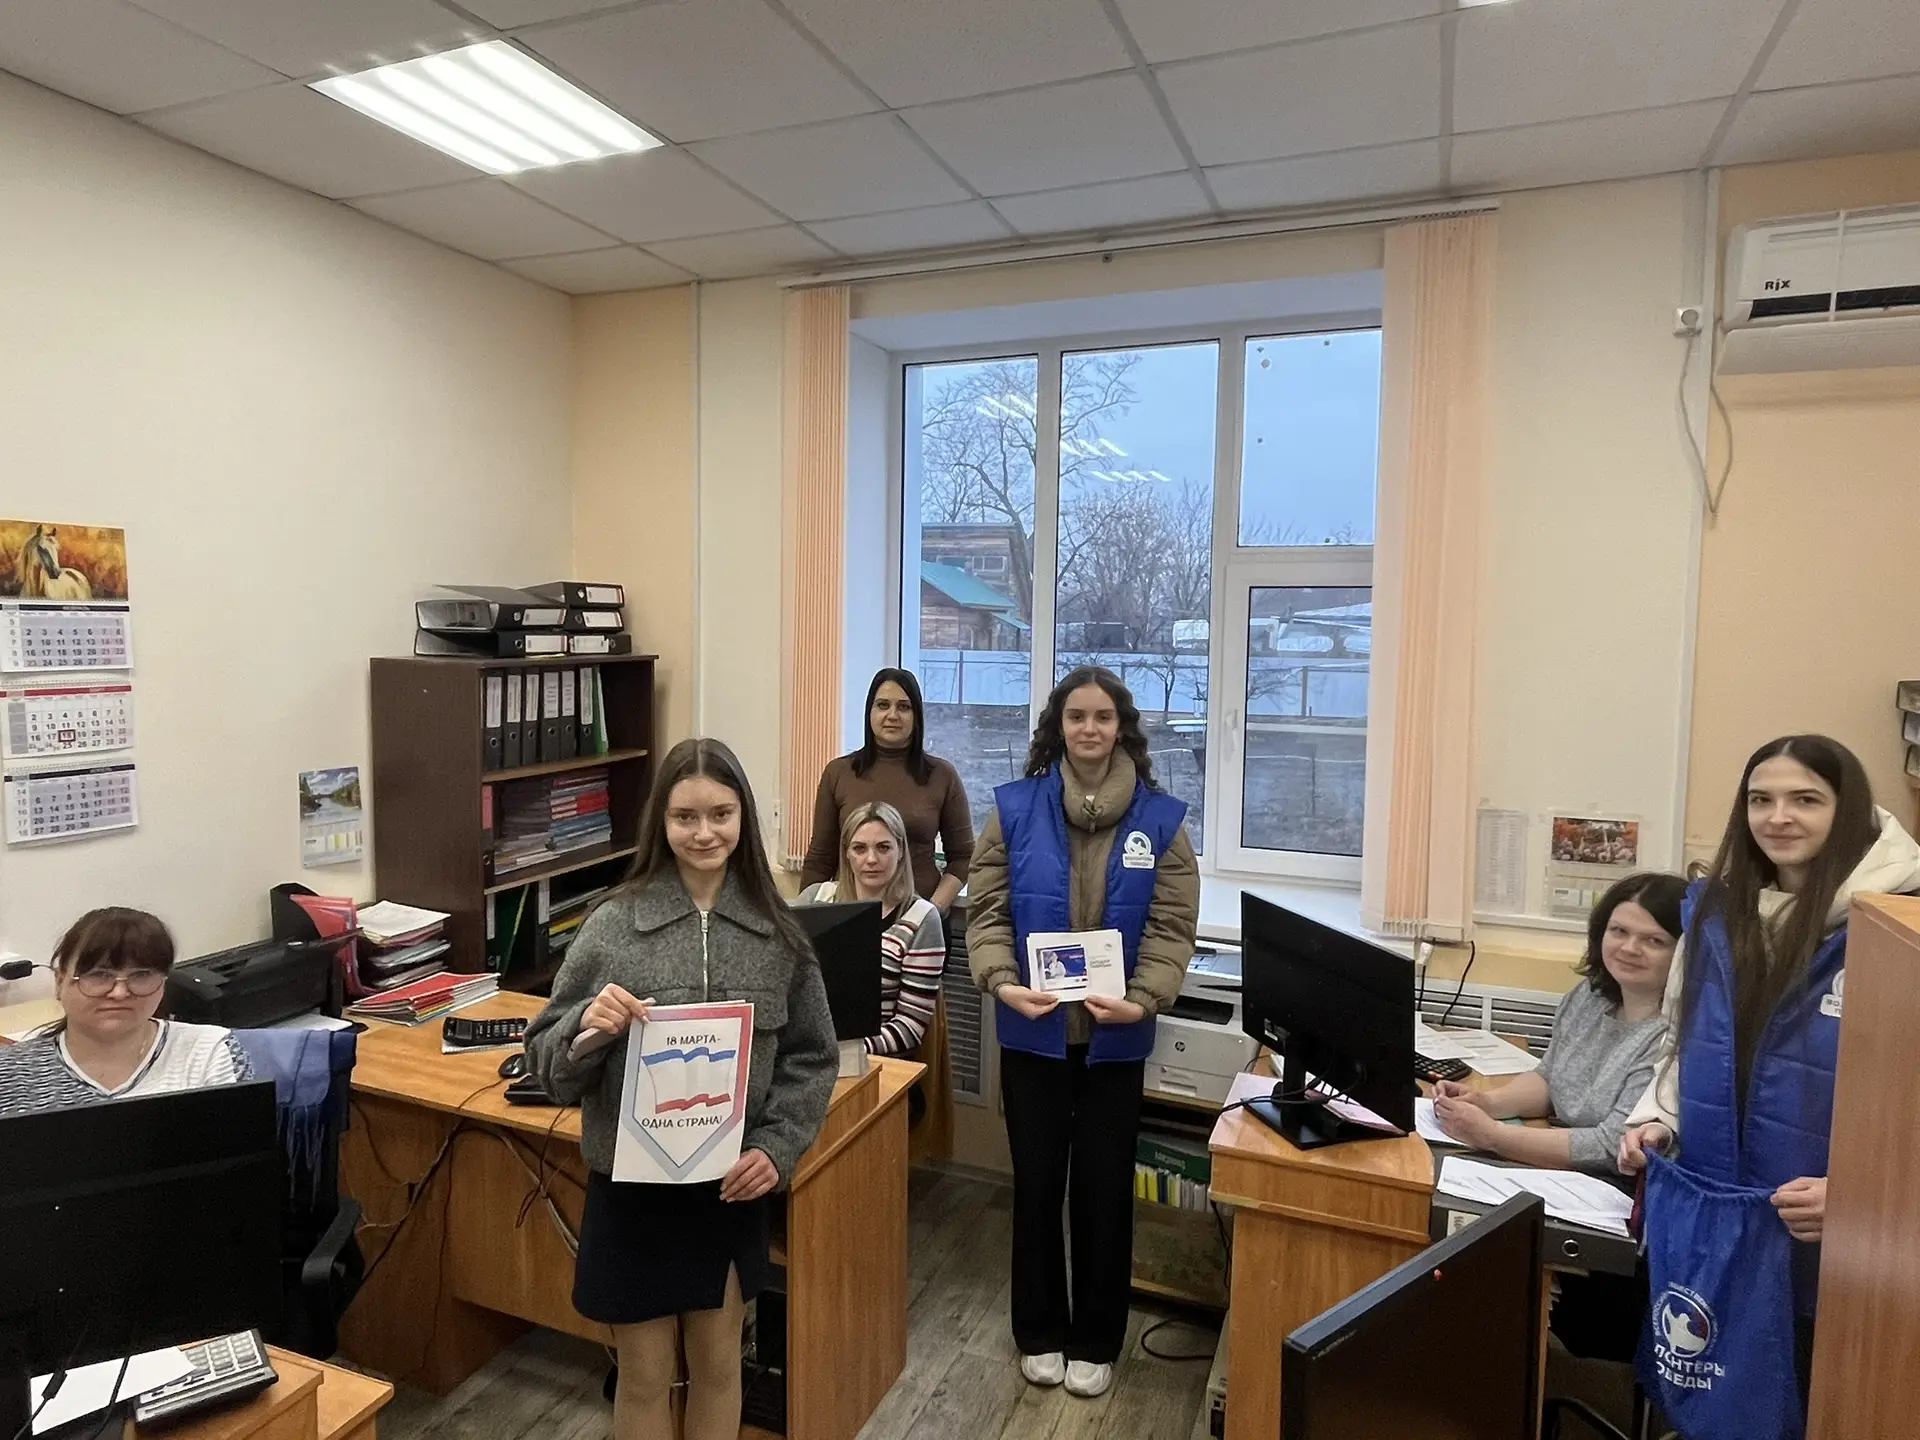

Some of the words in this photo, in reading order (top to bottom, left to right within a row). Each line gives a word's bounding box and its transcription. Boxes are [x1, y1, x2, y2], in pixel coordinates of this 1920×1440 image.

[666, 1037, 677, 1045] 18
[642, 1118, 673, 1128] ОДНА
[677, 1115, 723, 1128] СТРАНА!
